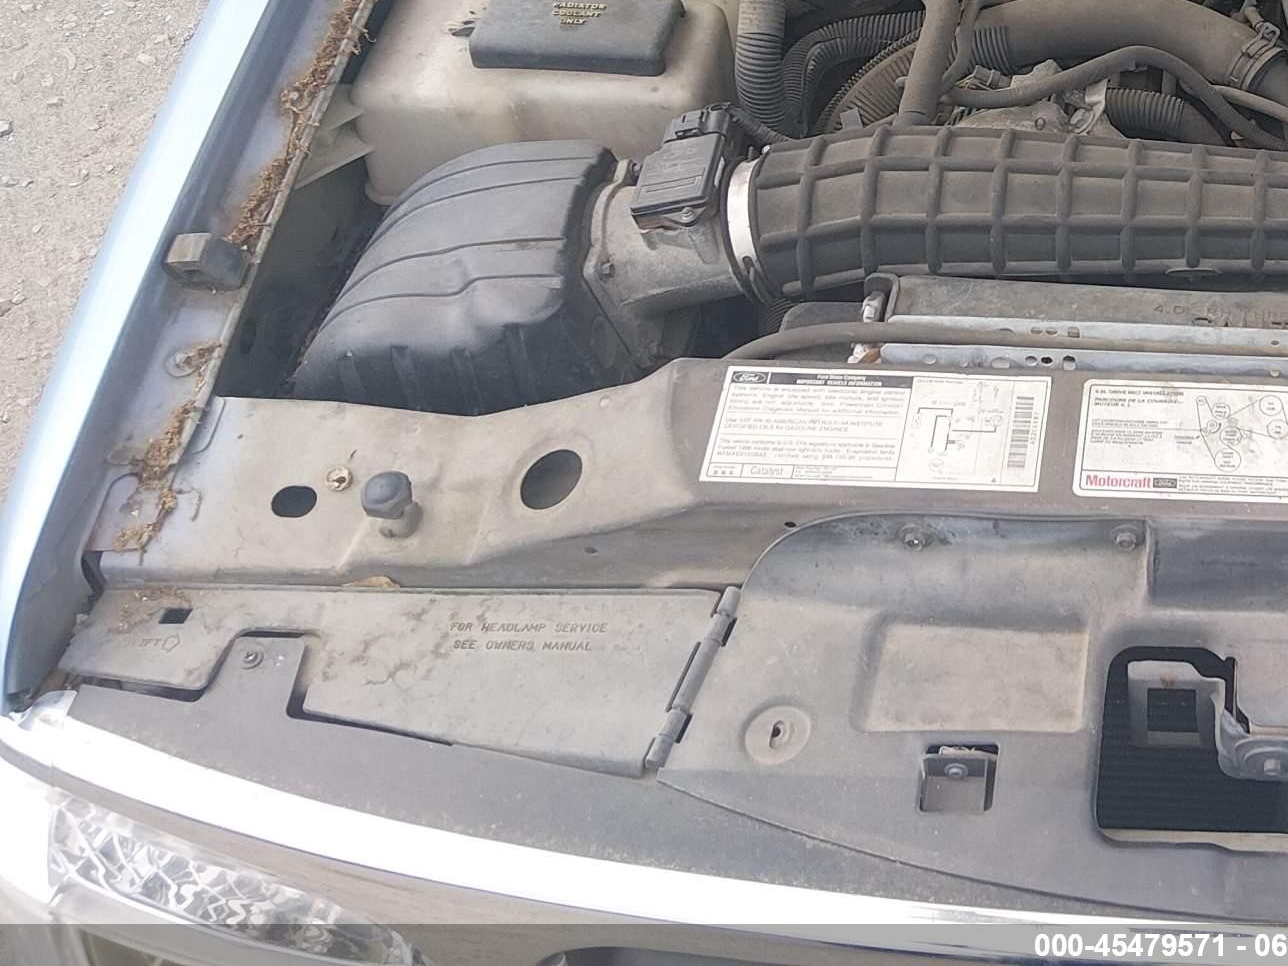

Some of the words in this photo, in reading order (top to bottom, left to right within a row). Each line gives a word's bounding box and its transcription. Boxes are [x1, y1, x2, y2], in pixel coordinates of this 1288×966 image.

[551, 2, 607, 10] RADIATOR
[551, 10, 601, 18] COOLANT
[749, 465, 784, 476] Catalyst
[1084, 474, 1151, 488] Motorcraft
[450, 622, 473, 633] FOR
[481, 622, 547, 633] HEADLAMP
[555, 622, 609, 633] SERVICE
[453, 640, 477, 650] SEE
[485, 640, 536, 651] OWNERS
[542, 640, 592, 651] MANUAL
